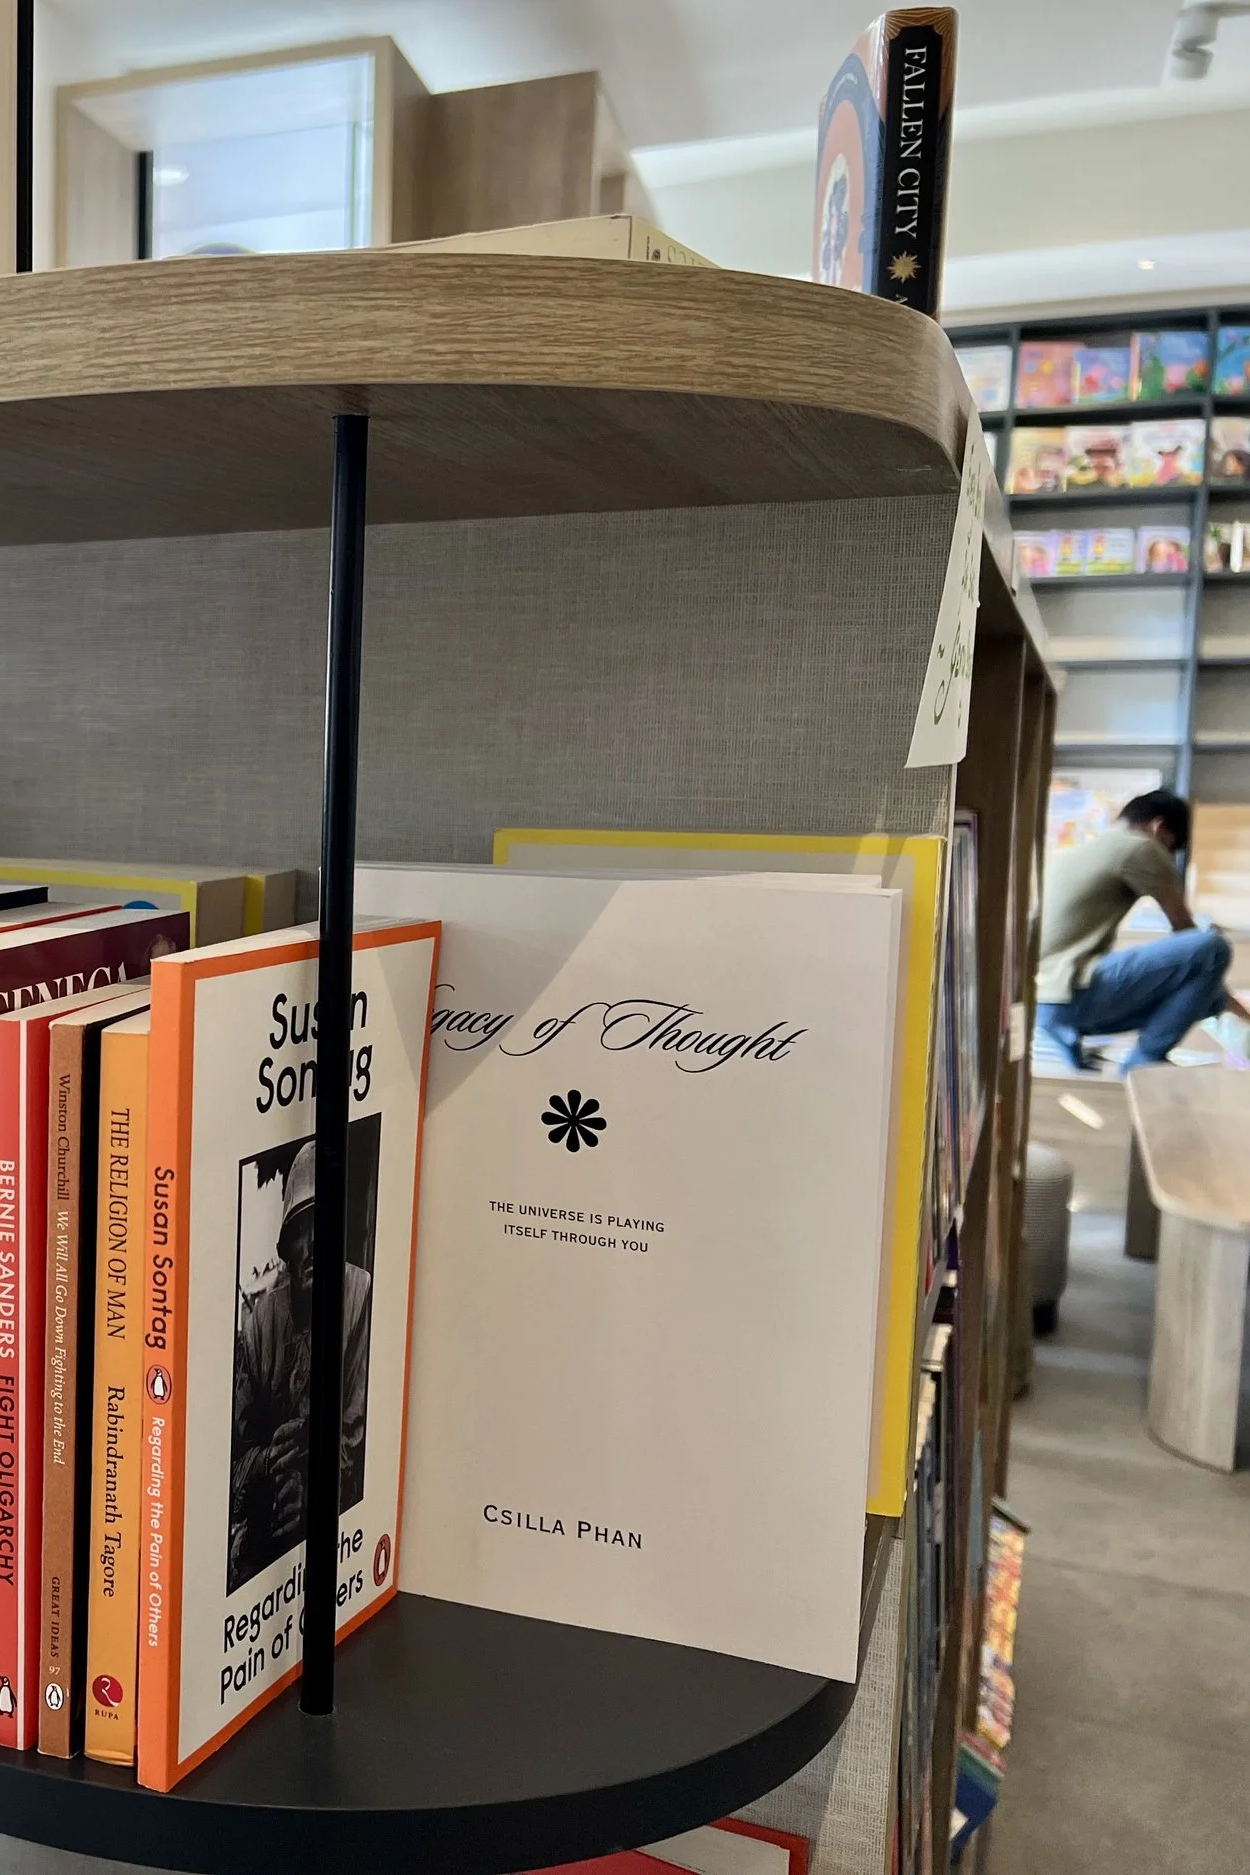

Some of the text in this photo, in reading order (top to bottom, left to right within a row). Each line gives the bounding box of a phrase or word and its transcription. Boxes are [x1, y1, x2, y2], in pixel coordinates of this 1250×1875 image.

[895, 46, 927, 240] FALLEN CITY
[499, 999, 809, 1073] of Thought
[0, 1160, 15, 1244] BERNIE
[107, 1107, 130, 1340] THE RELIGION OF MAN
[489, 1200, 665, 1233] THE UNIVERSE IS PLAYING
[504, 1224, 648, 1253] ITSELF THROUGH YOU
[51, 1074, 71, 1464] Winston Churchill We Will All Go Down Fighting to the End
[145, 1166, 175, 1350] Susan Sontag
[0, 1251, 15, 1359] SANDERS
[0, 1375, 15, 1443] FIGHT
[100, 1385, 126, 1598] Rabindranath Tagore
[147, 1416, 166, 1648] Regarding the Pain of Others
[50, 1576, 59, 1658] GREAT IDEAS
[221, 1614, 293, 1705] Pain of
[94, 1708, 119, 1720] RUPA
